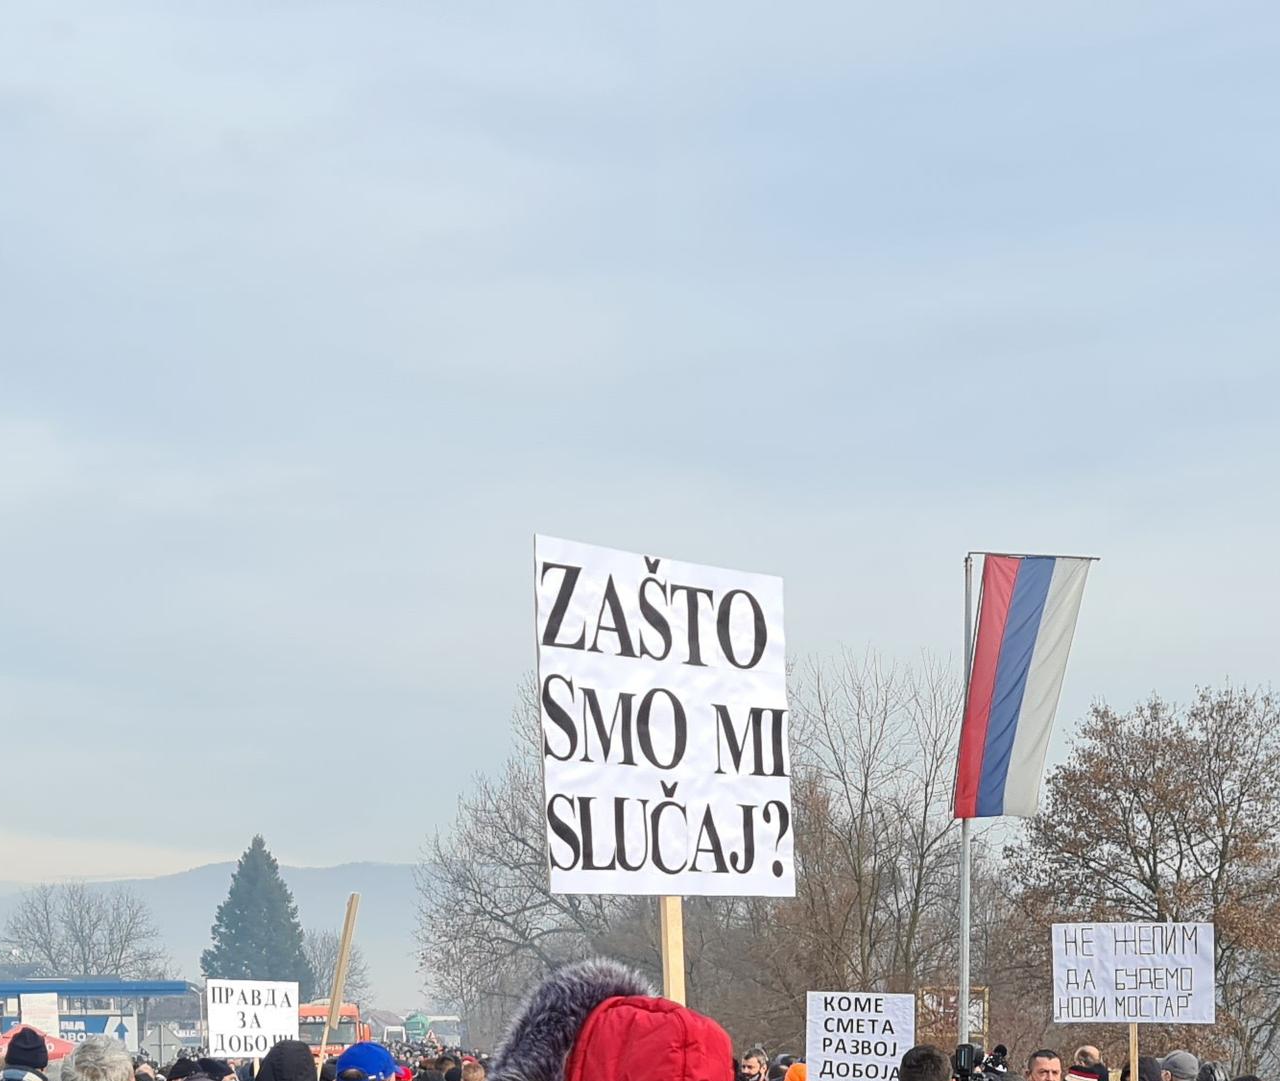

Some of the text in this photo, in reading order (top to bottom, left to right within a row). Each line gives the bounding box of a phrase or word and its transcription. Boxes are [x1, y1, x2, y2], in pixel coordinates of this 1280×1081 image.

[540, 556, 768, 670] ZAŠTO
[541, 674, 791, 777] SMO MI
[546, 780, 790, 878] SLUČAJ?
[1064, 925, 1198, 956] НЕ ЖЕЛИМ
[1066, 968, 1193, 991] ДА БУДЕМО
[211, 986, 292, 1009] ПРАВДА
[823, 996, 884, 1014] КОМЕ
[237, 1011, 261, 1029] ЗА
[823, 1017, 895, 1035] СМЕТА
[822, 1038, 898, 1058] РАЗВОЈ
[820, 1060, 901, 1081] ДОБОЈА
